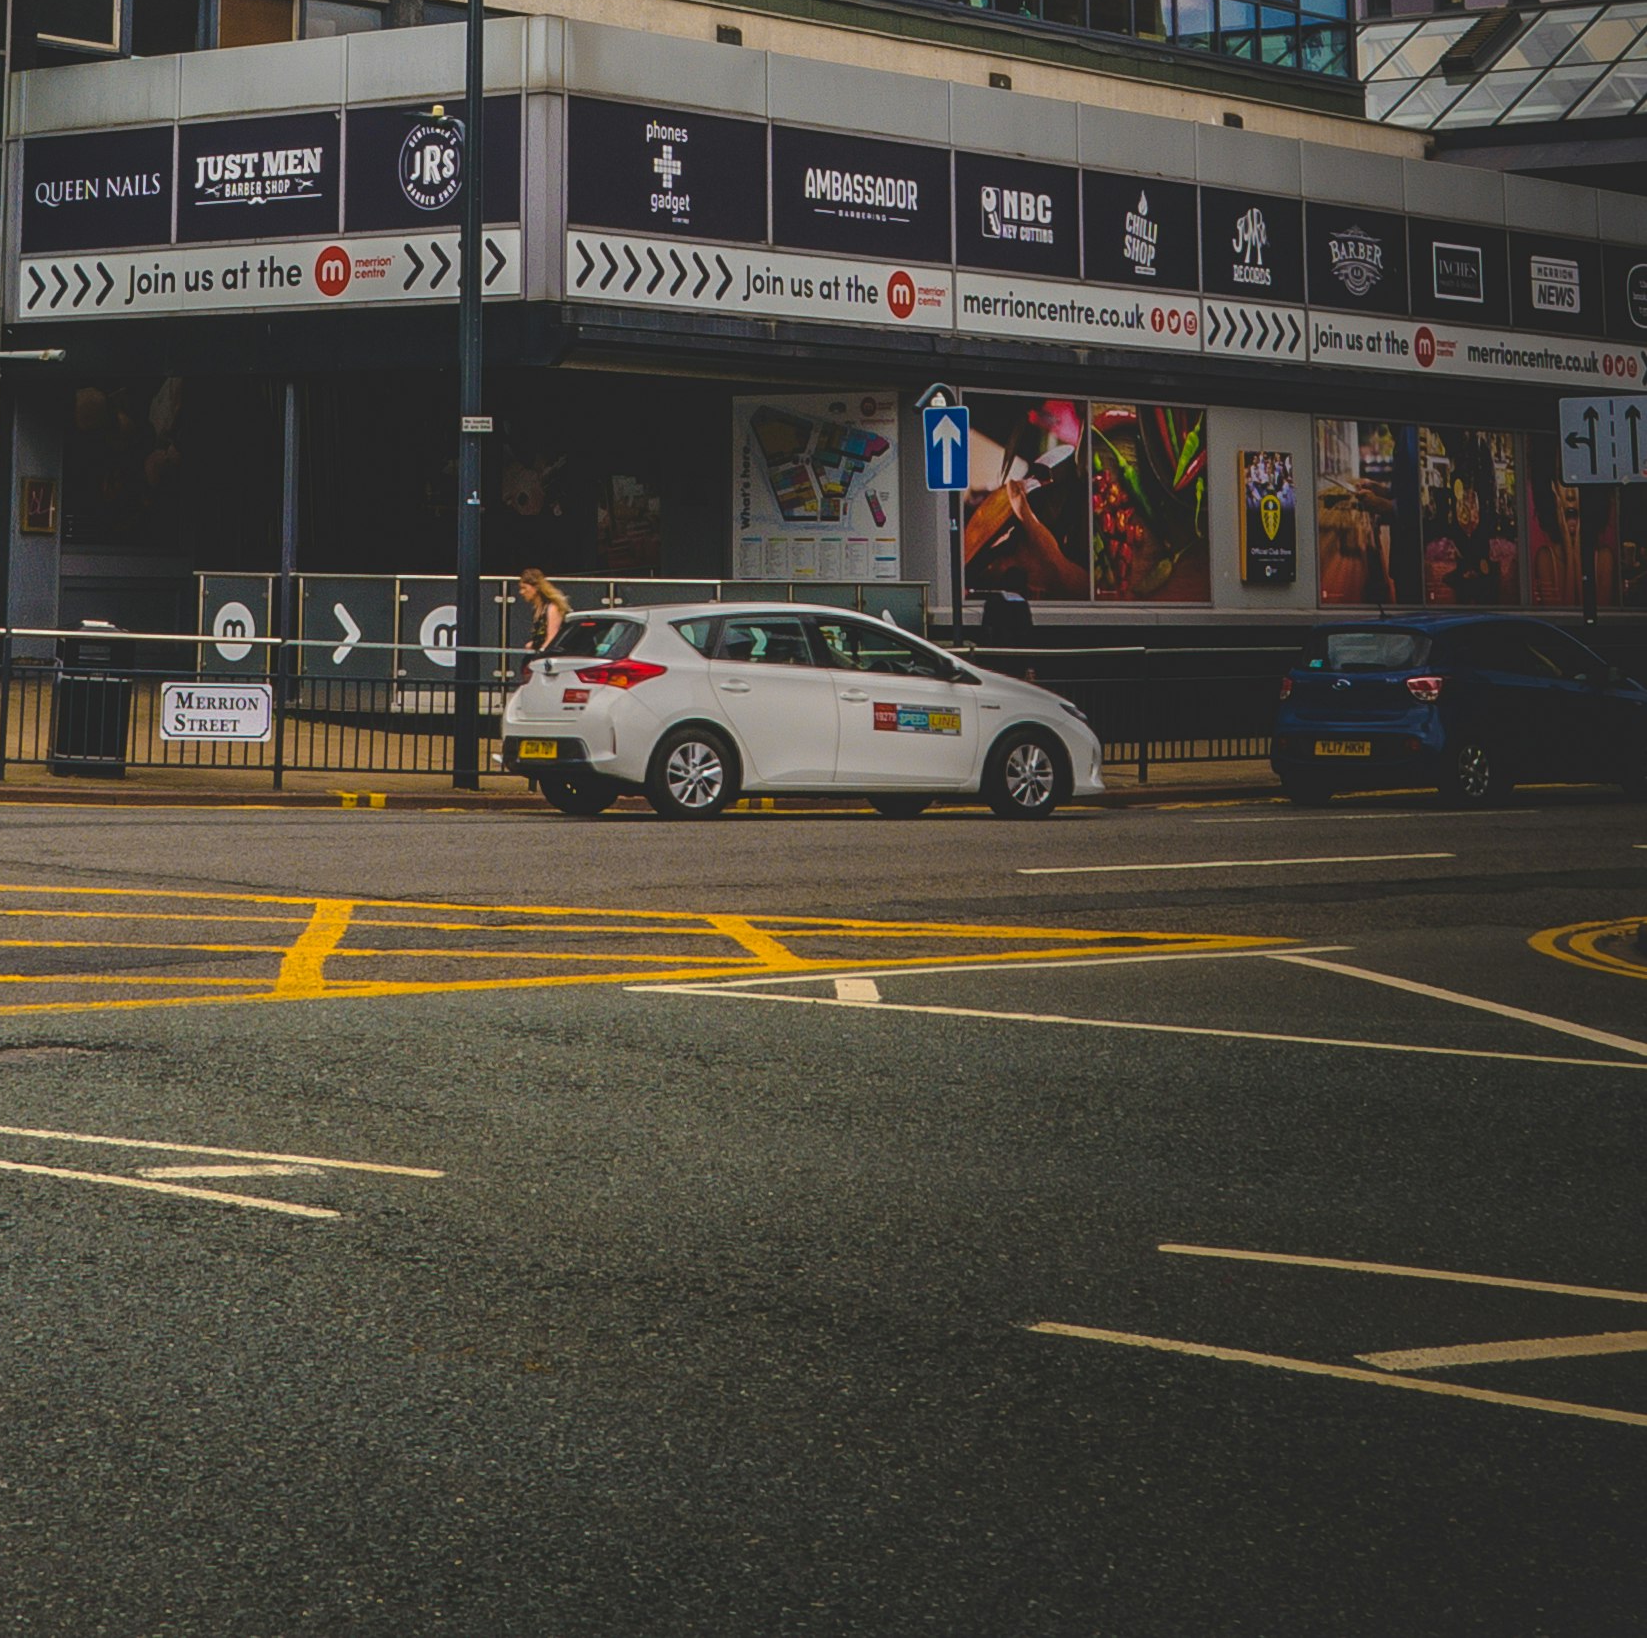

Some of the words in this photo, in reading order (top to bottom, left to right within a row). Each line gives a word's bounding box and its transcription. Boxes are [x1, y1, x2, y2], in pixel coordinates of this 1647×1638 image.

[646, 121, 688, 143] phones
[194, 152, 259, 189] JUST
[262, 147, 323, 177] MEN
[35, 177, 100, 208] QUEEN
[106, 172, 161, 200] NAILS
[224, 181, 262, 198] BARBER
[265, 179, 290, 195] SHOP
[438, 179, 457, 203] SHOP
[651, 190, 690, 214] gadget
[805, 167, 919, 211] AMBASSADOR
[1003, 189, 1052, 224] NBC
[1002, 224, 1017, 239] KEY
[1020, 226, 1054, 245] CUTTING
[1125, 211, 1158, 244] CHILLI
[355, 256, 392, 268] merrion
[1123, 234, 1156, 267] SHOP
[1328, 240, 1384, 270] BARBER
[125, 263, 175, 304] Join
[185, 266, 214, 293] us
[222, 260, 251, 290] at
[258, 256, 302, 288] the
[354, 267, 386, 279] centre
[742, 265, 784, 301] Join
[790, 275, 814, 298] us
[818, 276, 843, 300] at
[846, 275, 879, 304] the
[1233, 264, 1271, 286] RECORDS
[1537, 284, 1575, 308] NEWS
[963, 290, 1145, 330] merrioncentre.co.uk
[1312, 322, 1343, 355] Join
[1346, 333, 1364, 351] us
[1366, 331, 1382, 353] at
[1385, 330, 1409, 355] the
[1467, 341, 1600, 374] merrioncentre.co.uk
[174, 691, 260, 712] MERRION
[173, 713, 241, 733] STREET
[932, 715, 958, 728] LINE
